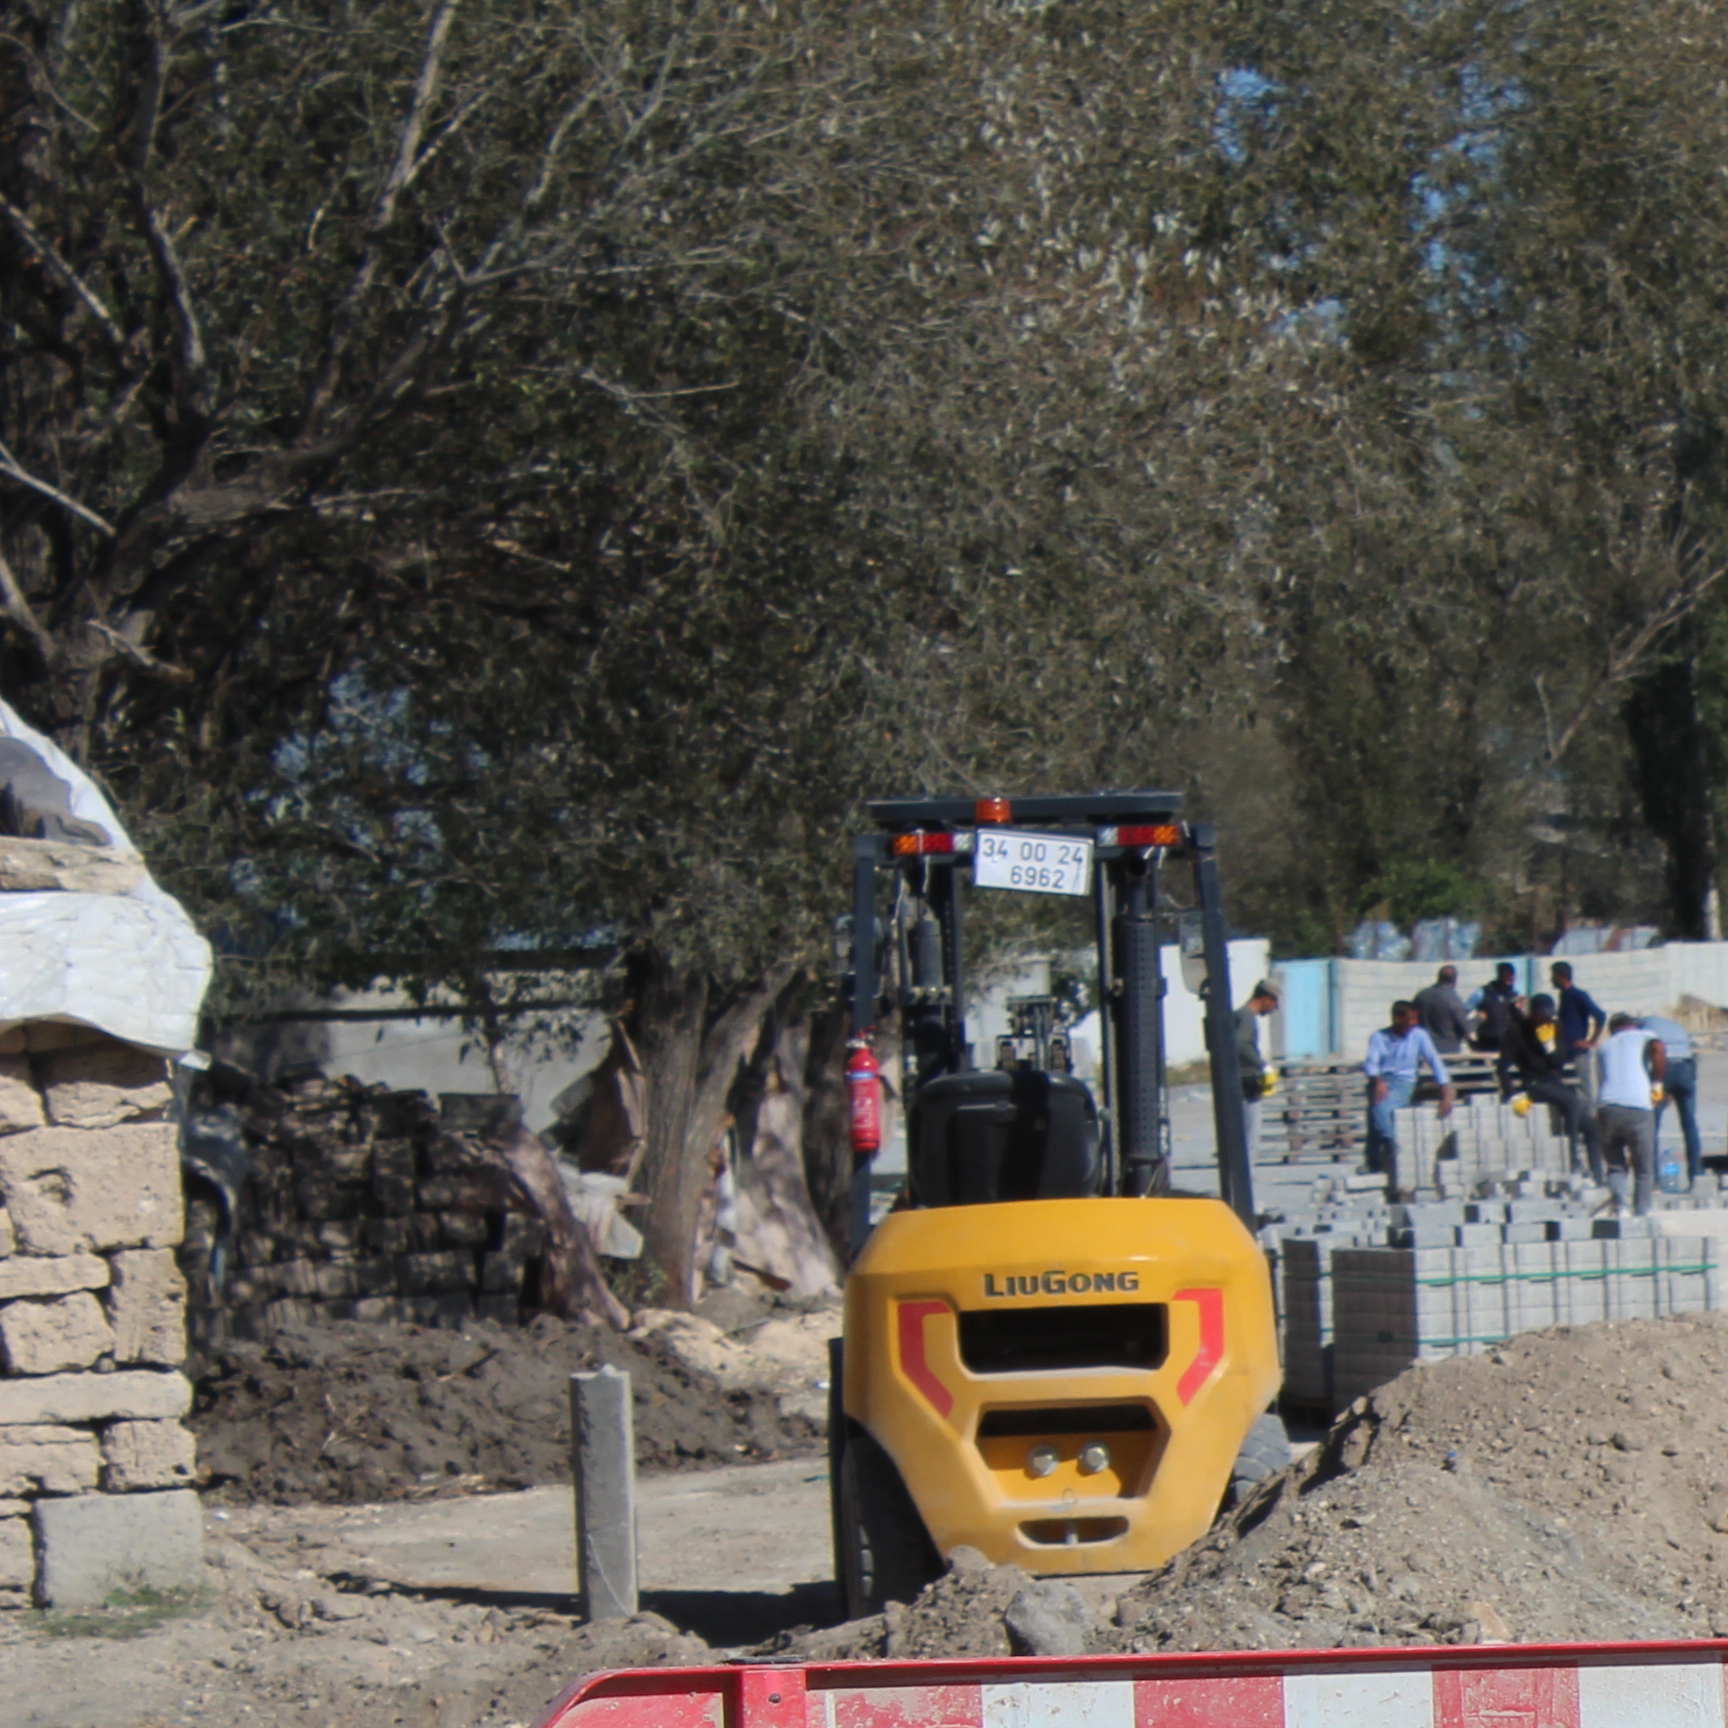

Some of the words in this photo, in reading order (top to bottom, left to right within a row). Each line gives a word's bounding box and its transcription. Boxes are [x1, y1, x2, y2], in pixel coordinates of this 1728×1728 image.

[983, 838, 1008, 858] 34
[1059, 845, 1084, 865] 24
[1011, 865, 1064, 889] 6962
